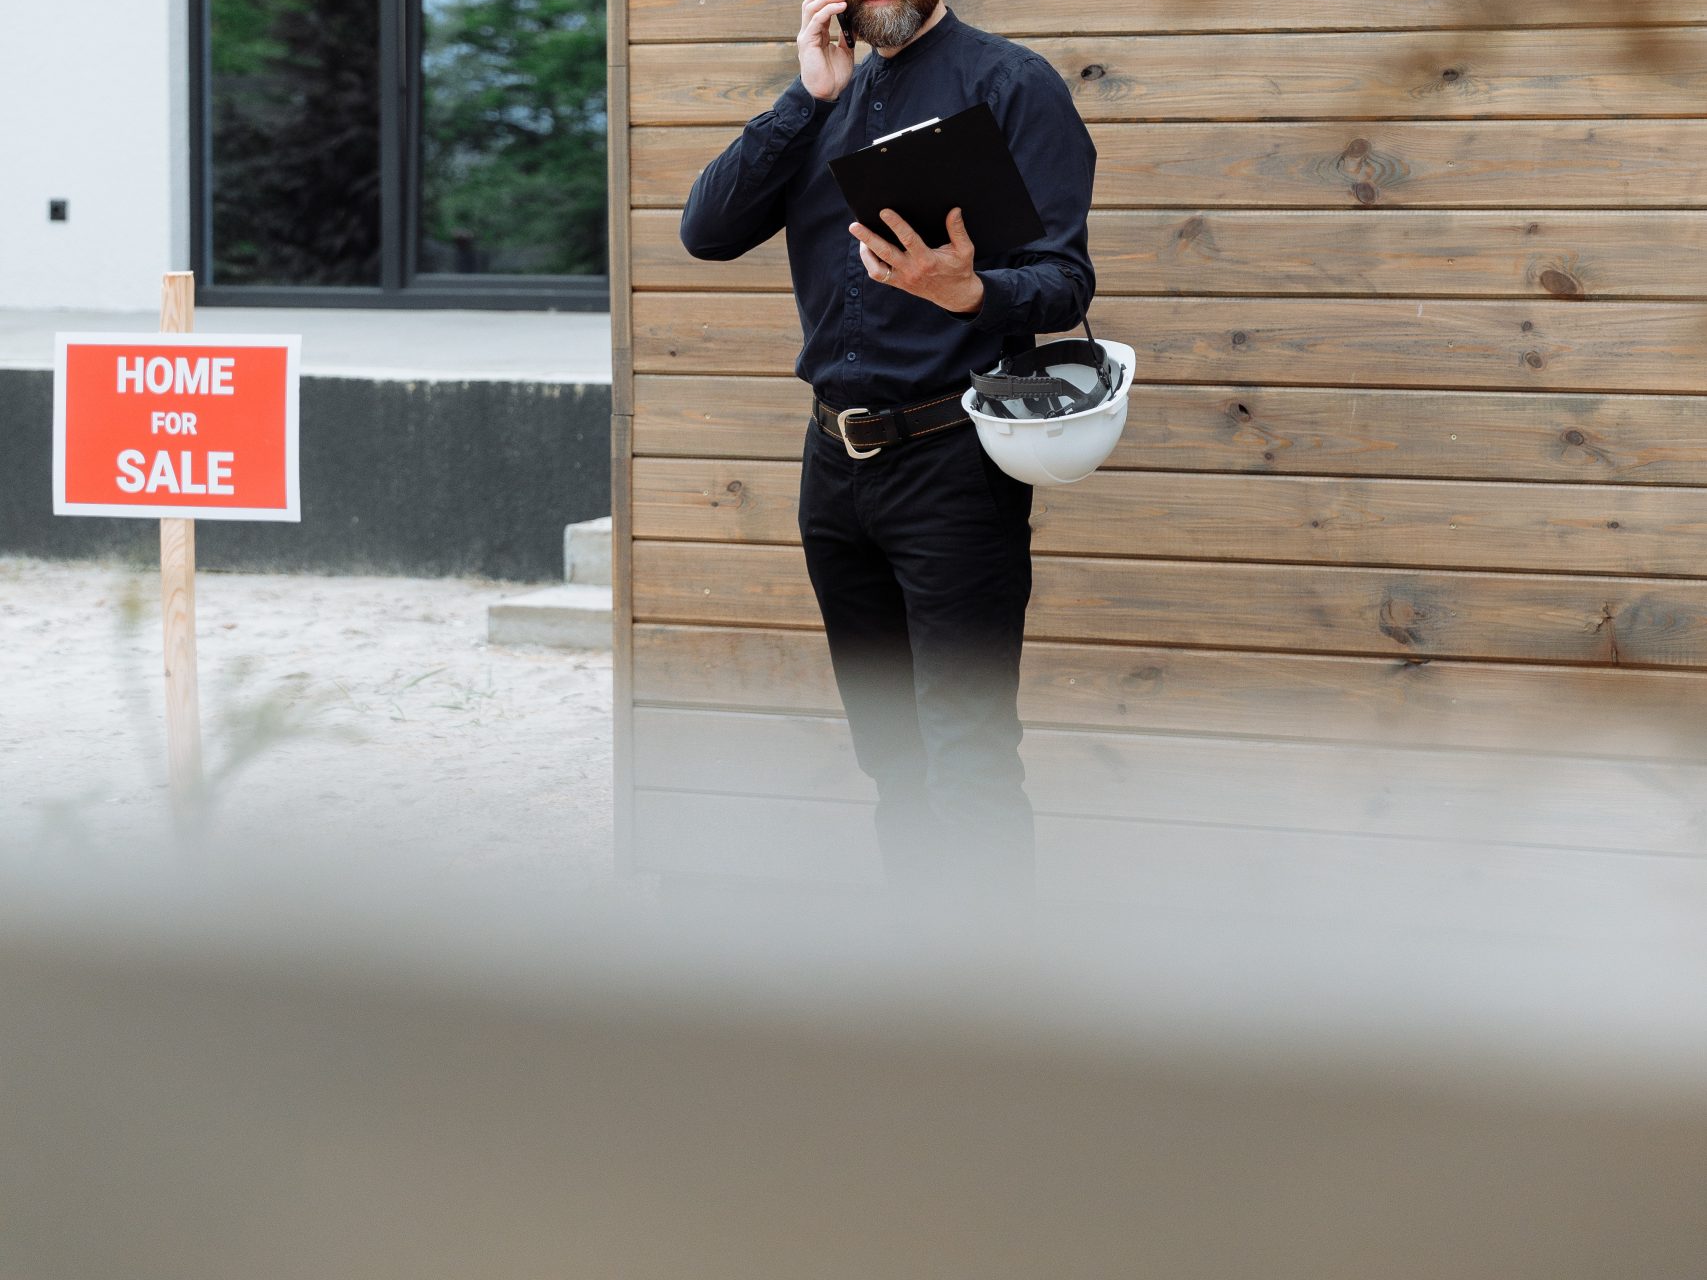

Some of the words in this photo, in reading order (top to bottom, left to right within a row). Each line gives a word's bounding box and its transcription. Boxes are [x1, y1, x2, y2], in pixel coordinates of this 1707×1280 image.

[116, 356, 235, 395] HOME
[151, 411, 197, 435] FOR
[116, 449, 234, 495] SALE
